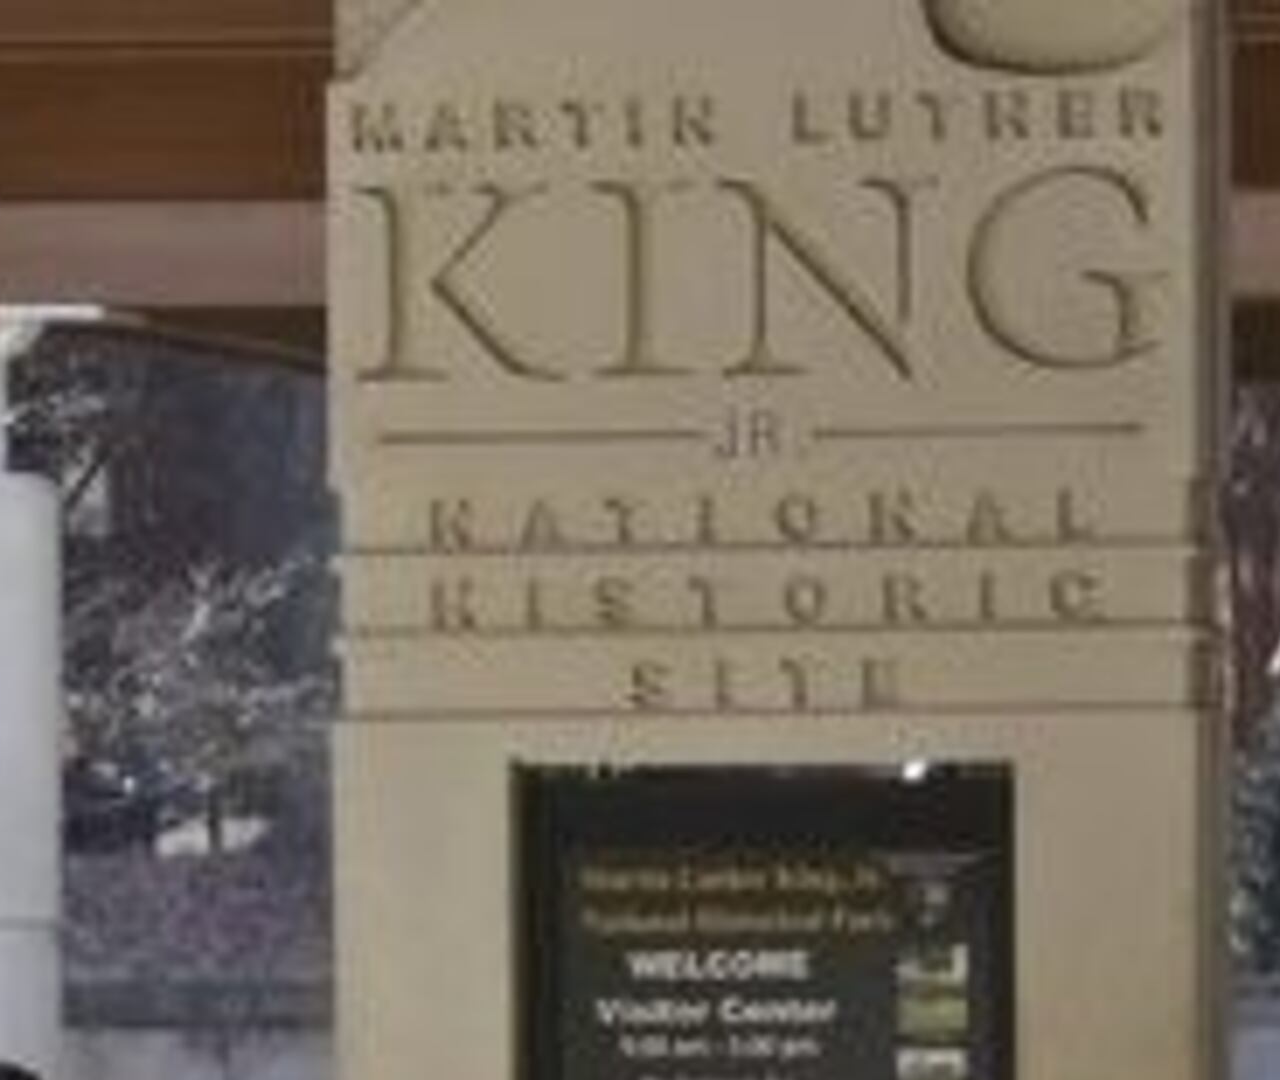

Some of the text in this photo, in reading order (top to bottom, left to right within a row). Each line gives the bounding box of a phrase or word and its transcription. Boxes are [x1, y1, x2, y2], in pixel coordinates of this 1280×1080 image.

[349, 87, 1166, 154] MARTIN LUTHER
[354, 163, 1172, 384] KING
[429, 488, 1095, 550] NATIONAL
[429, 570, 1108, 632] HISTORIC
[628, 657, 902, 712] SITE
[626, 950, 811, 980] WELCOME
[597, 996, 838, 1024] Visitor Center
